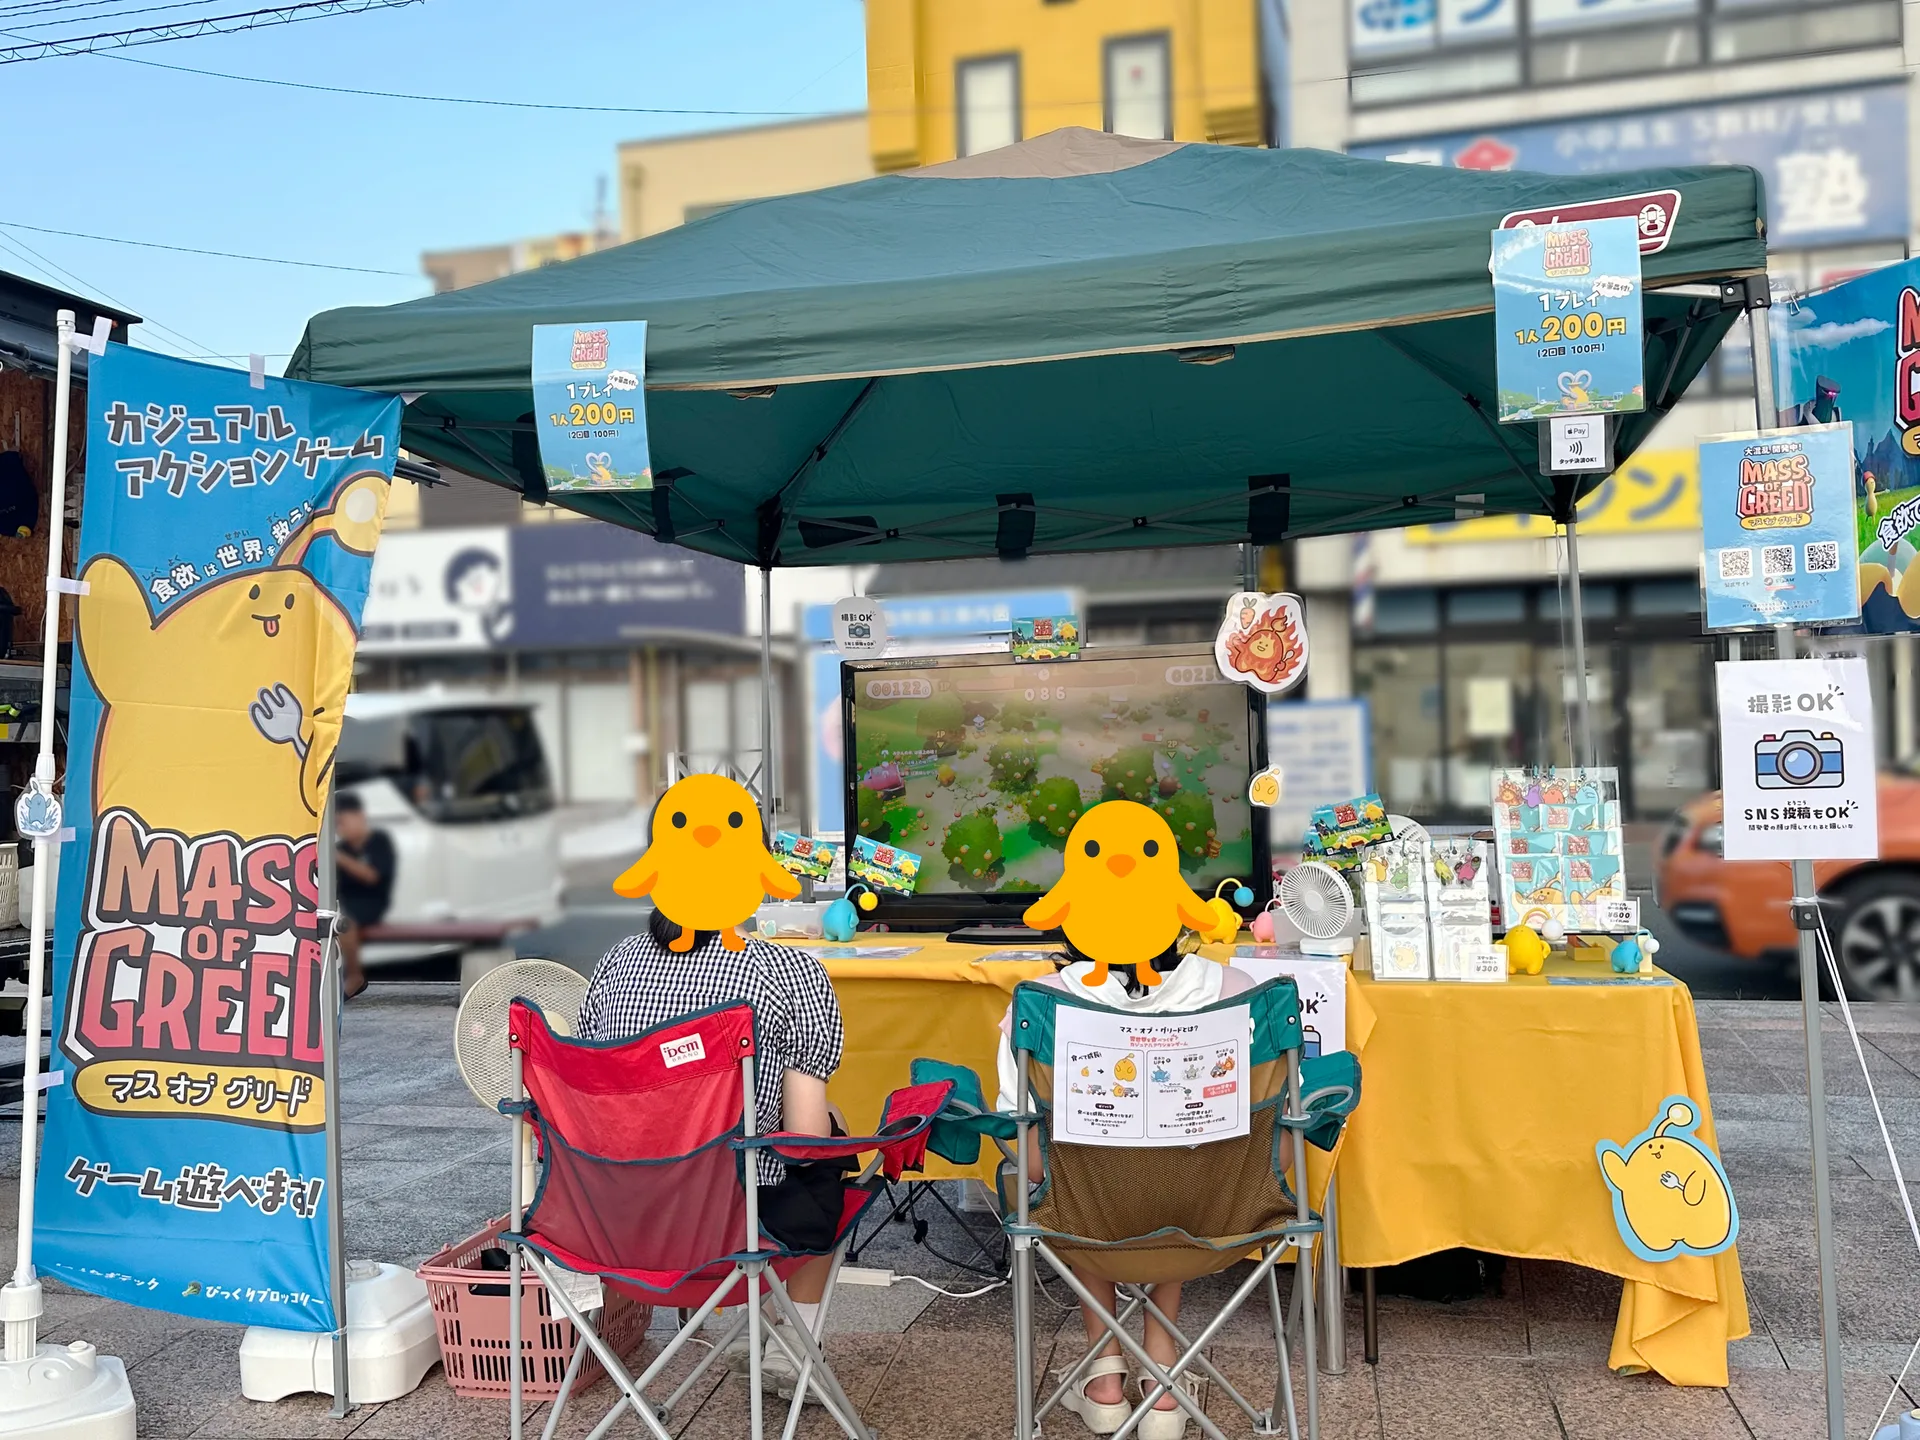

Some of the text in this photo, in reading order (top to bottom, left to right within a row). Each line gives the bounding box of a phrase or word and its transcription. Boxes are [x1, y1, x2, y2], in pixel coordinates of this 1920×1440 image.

[1546, 229, 1588, 248] MASS
[1545, 245, 1589, 269] GREED
[574, 330, 607, 344] MASS
[573, 343, 605, 361] GREED
[105, 401, 296, 446] カジュアル
[1573, 427, 1587, 435] Pay
[115, 434, 385, 498] アクションゲーム
[1742, 455, 1806, 484] MASS
[1740, 480, 1809, 516] GREED
[1765, 481, 1781, 491] OF
[872, 680, 921, 697] 00122
[1167, 740, 1178, 748] 2P
[102, 816, 318, 929] MASS
[187, 925, 249, 962] OF
[81, 925, 324, 1063] GREED
[672, 1051, 699, 1062] BRAND
[105, 1070, 313, 1117] マス オブ グリード
[65, 1155, 325, 1218] ゲーム遊べます!
[205, 1285, 325, 1306] びっくりブロッコリー
